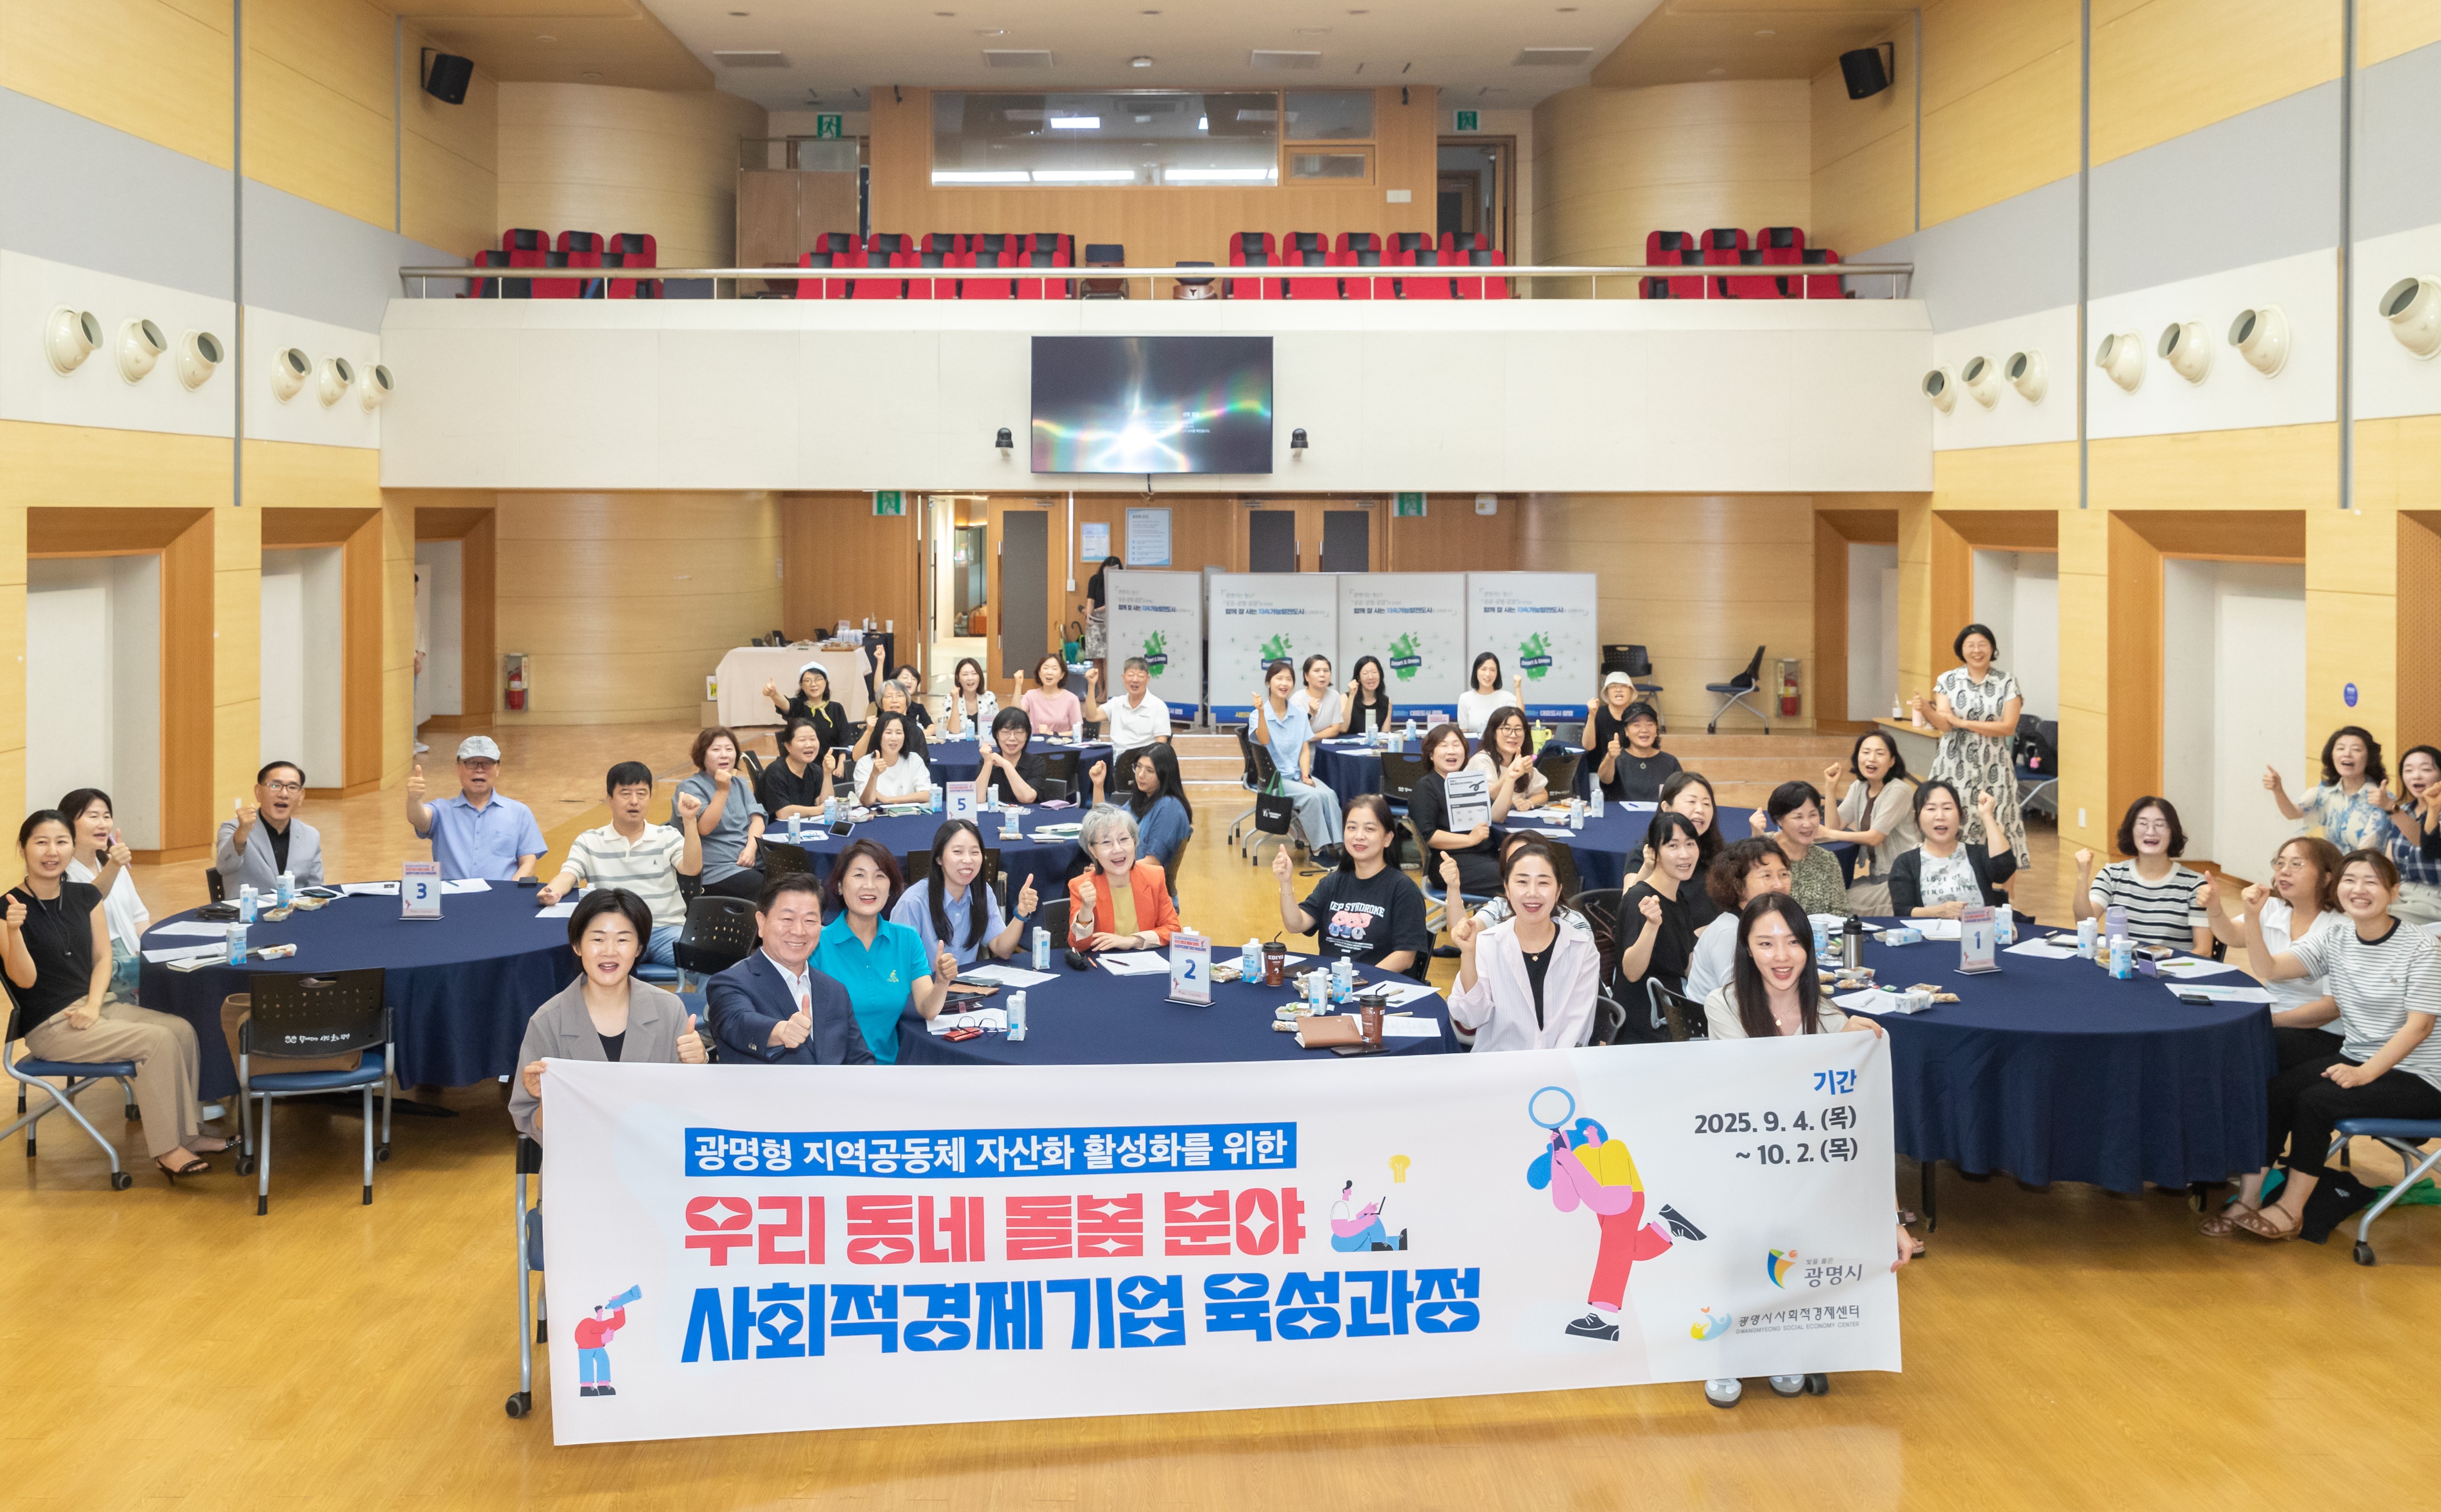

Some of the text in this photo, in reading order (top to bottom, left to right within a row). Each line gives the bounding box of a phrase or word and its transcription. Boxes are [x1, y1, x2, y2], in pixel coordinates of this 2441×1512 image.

[958, 798, 966, 811] 5
[416, 882, 427, 899] 3
[1344, 902, 1385, 917] SYNDROME
[1974, 931, 1980, 949] 1
[1184, 959, 1196, 980] 2
[1814, 1069, 1857, 1095] 기간
[1695, 1105, 1856, 1134] 2025. 9. 4. (목)
[695, 1130, 1287, 1173] 광명형 지역공동체 자산화 활성화를 위한
[1757, 1144, 1790, 1165] 10.
[1797, 1143, 1814, 1163] 2.
[1820, 1138, 1858, 1162] (목)
[685, 1188, 1306, 1266] 우리 동네 돌봄 분야
[1804, 1264, 1862, 1288] 광명시
[681, 1267, 1480, 1363] 사회적경제기업 육성과정
[1738, 1305, 1860, 1327] 광명시사회적경제센터
[1735, 1326, 1781, 1334] GWANGMYEONG
